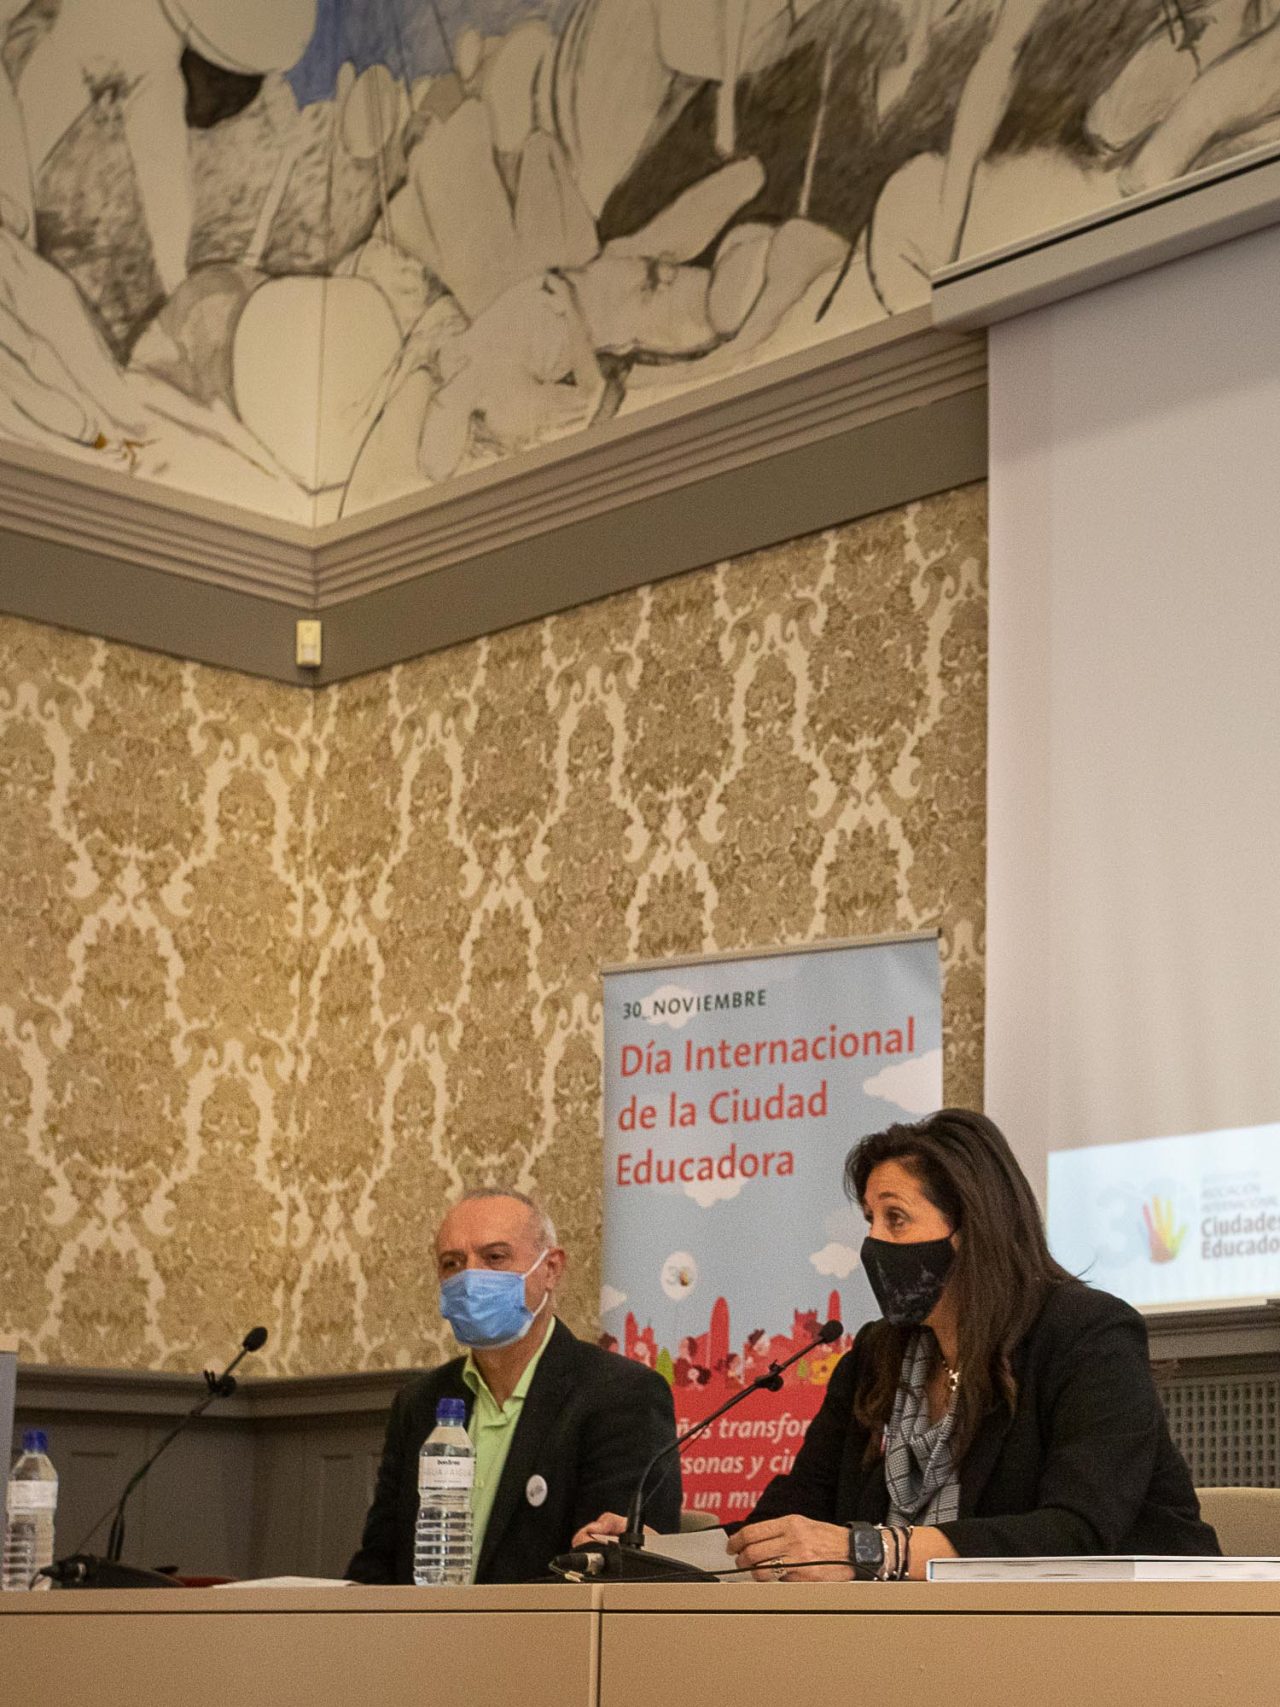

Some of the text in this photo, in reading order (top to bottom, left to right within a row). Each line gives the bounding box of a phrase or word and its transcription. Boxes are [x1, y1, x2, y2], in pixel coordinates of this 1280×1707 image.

[620, 1016, 916, 1078] Día Internacional
[618, 1081, 828, 1132] de la Ciudad
[616, 1144, 795, 1188] Educadora
[680, 1456, 744, 1475] sonas
[745, 1455, 764, 1480] y
[694, 1491, 723, 1509] un
